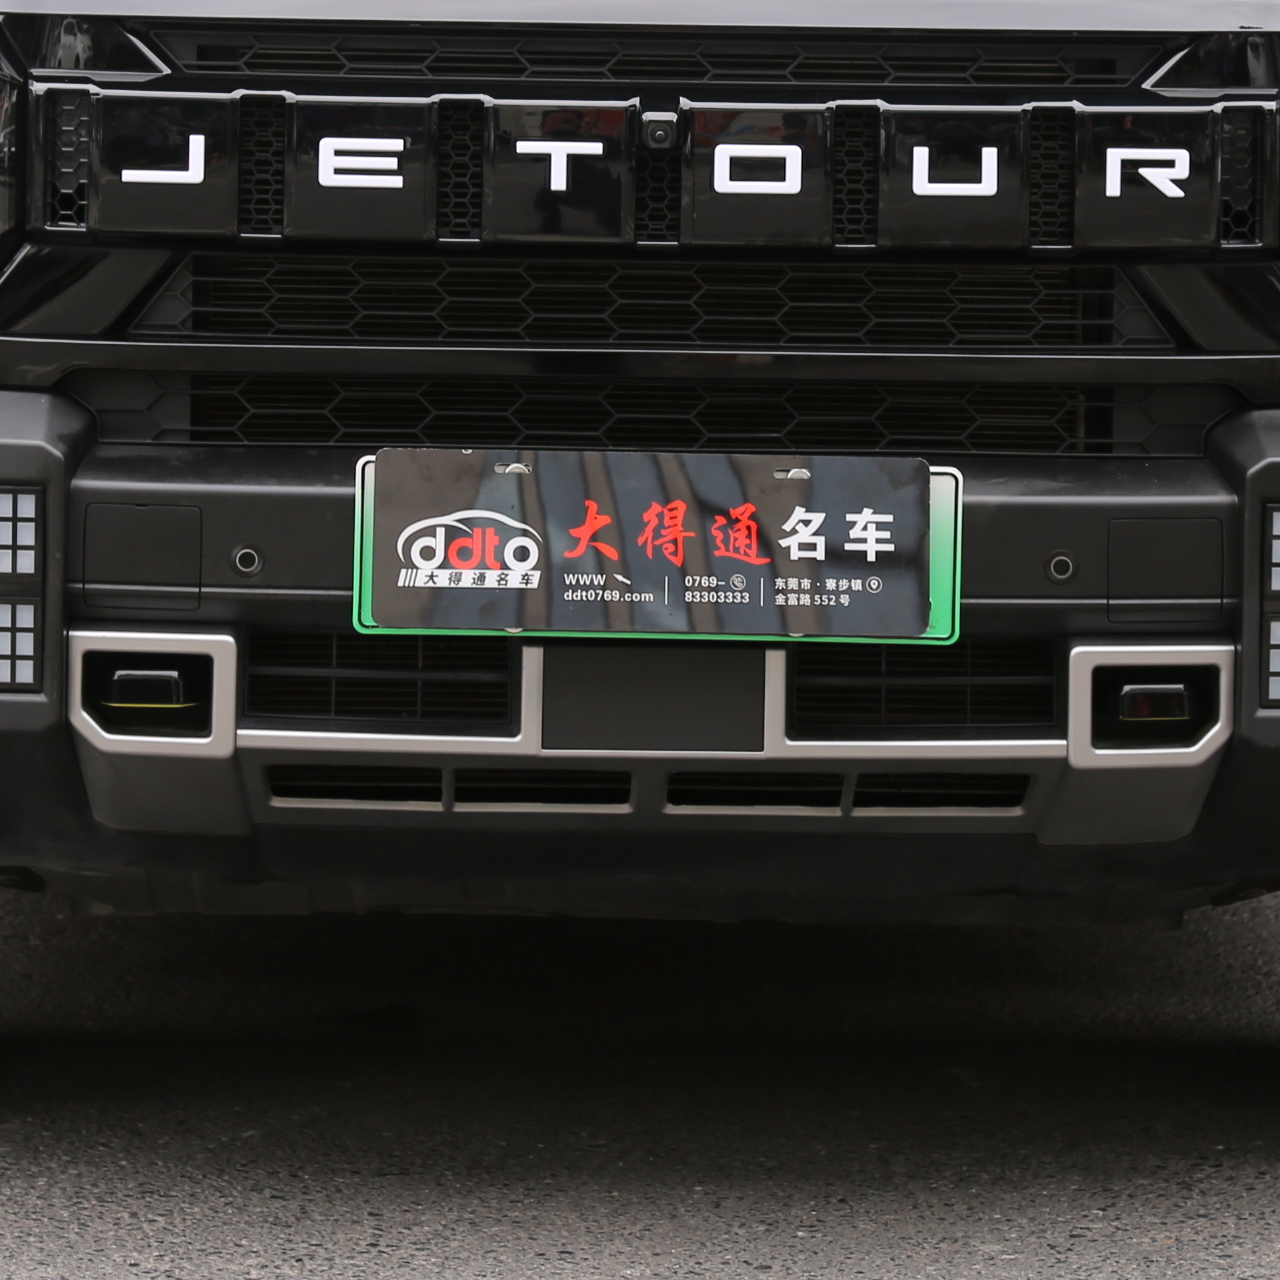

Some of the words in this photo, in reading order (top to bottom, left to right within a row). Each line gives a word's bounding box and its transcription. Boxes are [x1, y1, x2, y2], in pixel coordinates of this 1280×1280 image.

[121, 132, 1190, 198] JETOUR
[563, 499, 895, 568] 大得通名车
[423, 571, 535, 587] 大得通名车
[563, 588, 654, 602] ddt0769.com
[684, 590, 750, 604] 83303333
